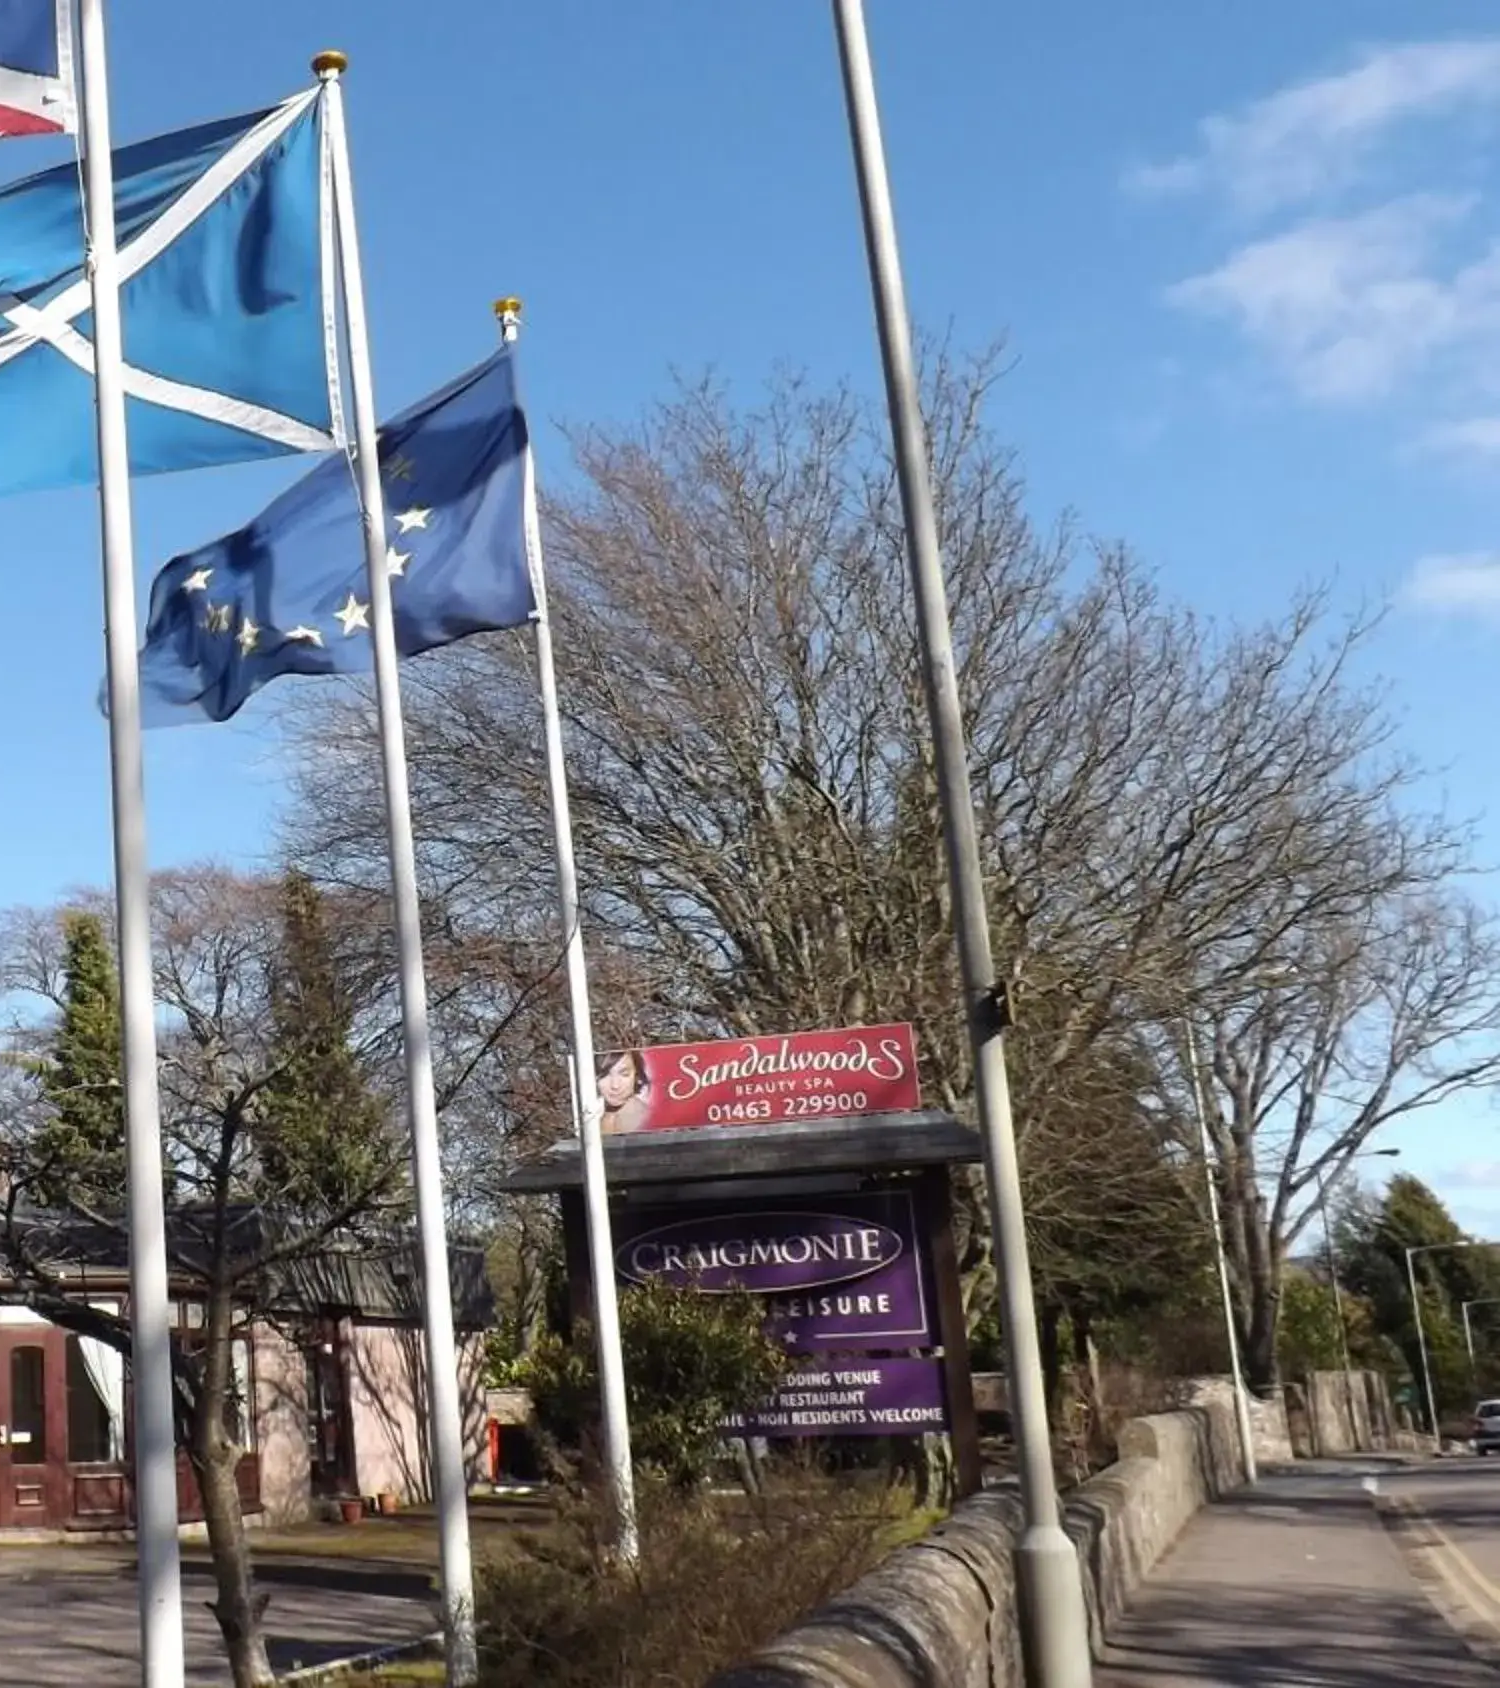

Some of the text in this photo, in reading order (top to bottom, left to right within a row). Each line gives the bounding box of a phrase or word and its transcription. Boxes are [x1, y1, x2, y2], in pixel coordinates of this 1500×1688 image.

[735, 1077, 835, 1097] BEAUTY SPA
[707, 1092, 867, 1122] 01463 229900
[631, 1228, 882, 1275] CRAIGMONIE
[780, 1370, 882, 1388] EDDING VENUE
[780, 1390, 865, 1408] RESTAURANT
[758, 1411, 788, 1426] NON
[791, 1409, 866, 1425] RESIDENTS
[869, 1407, 943, 1423] WELCOME
